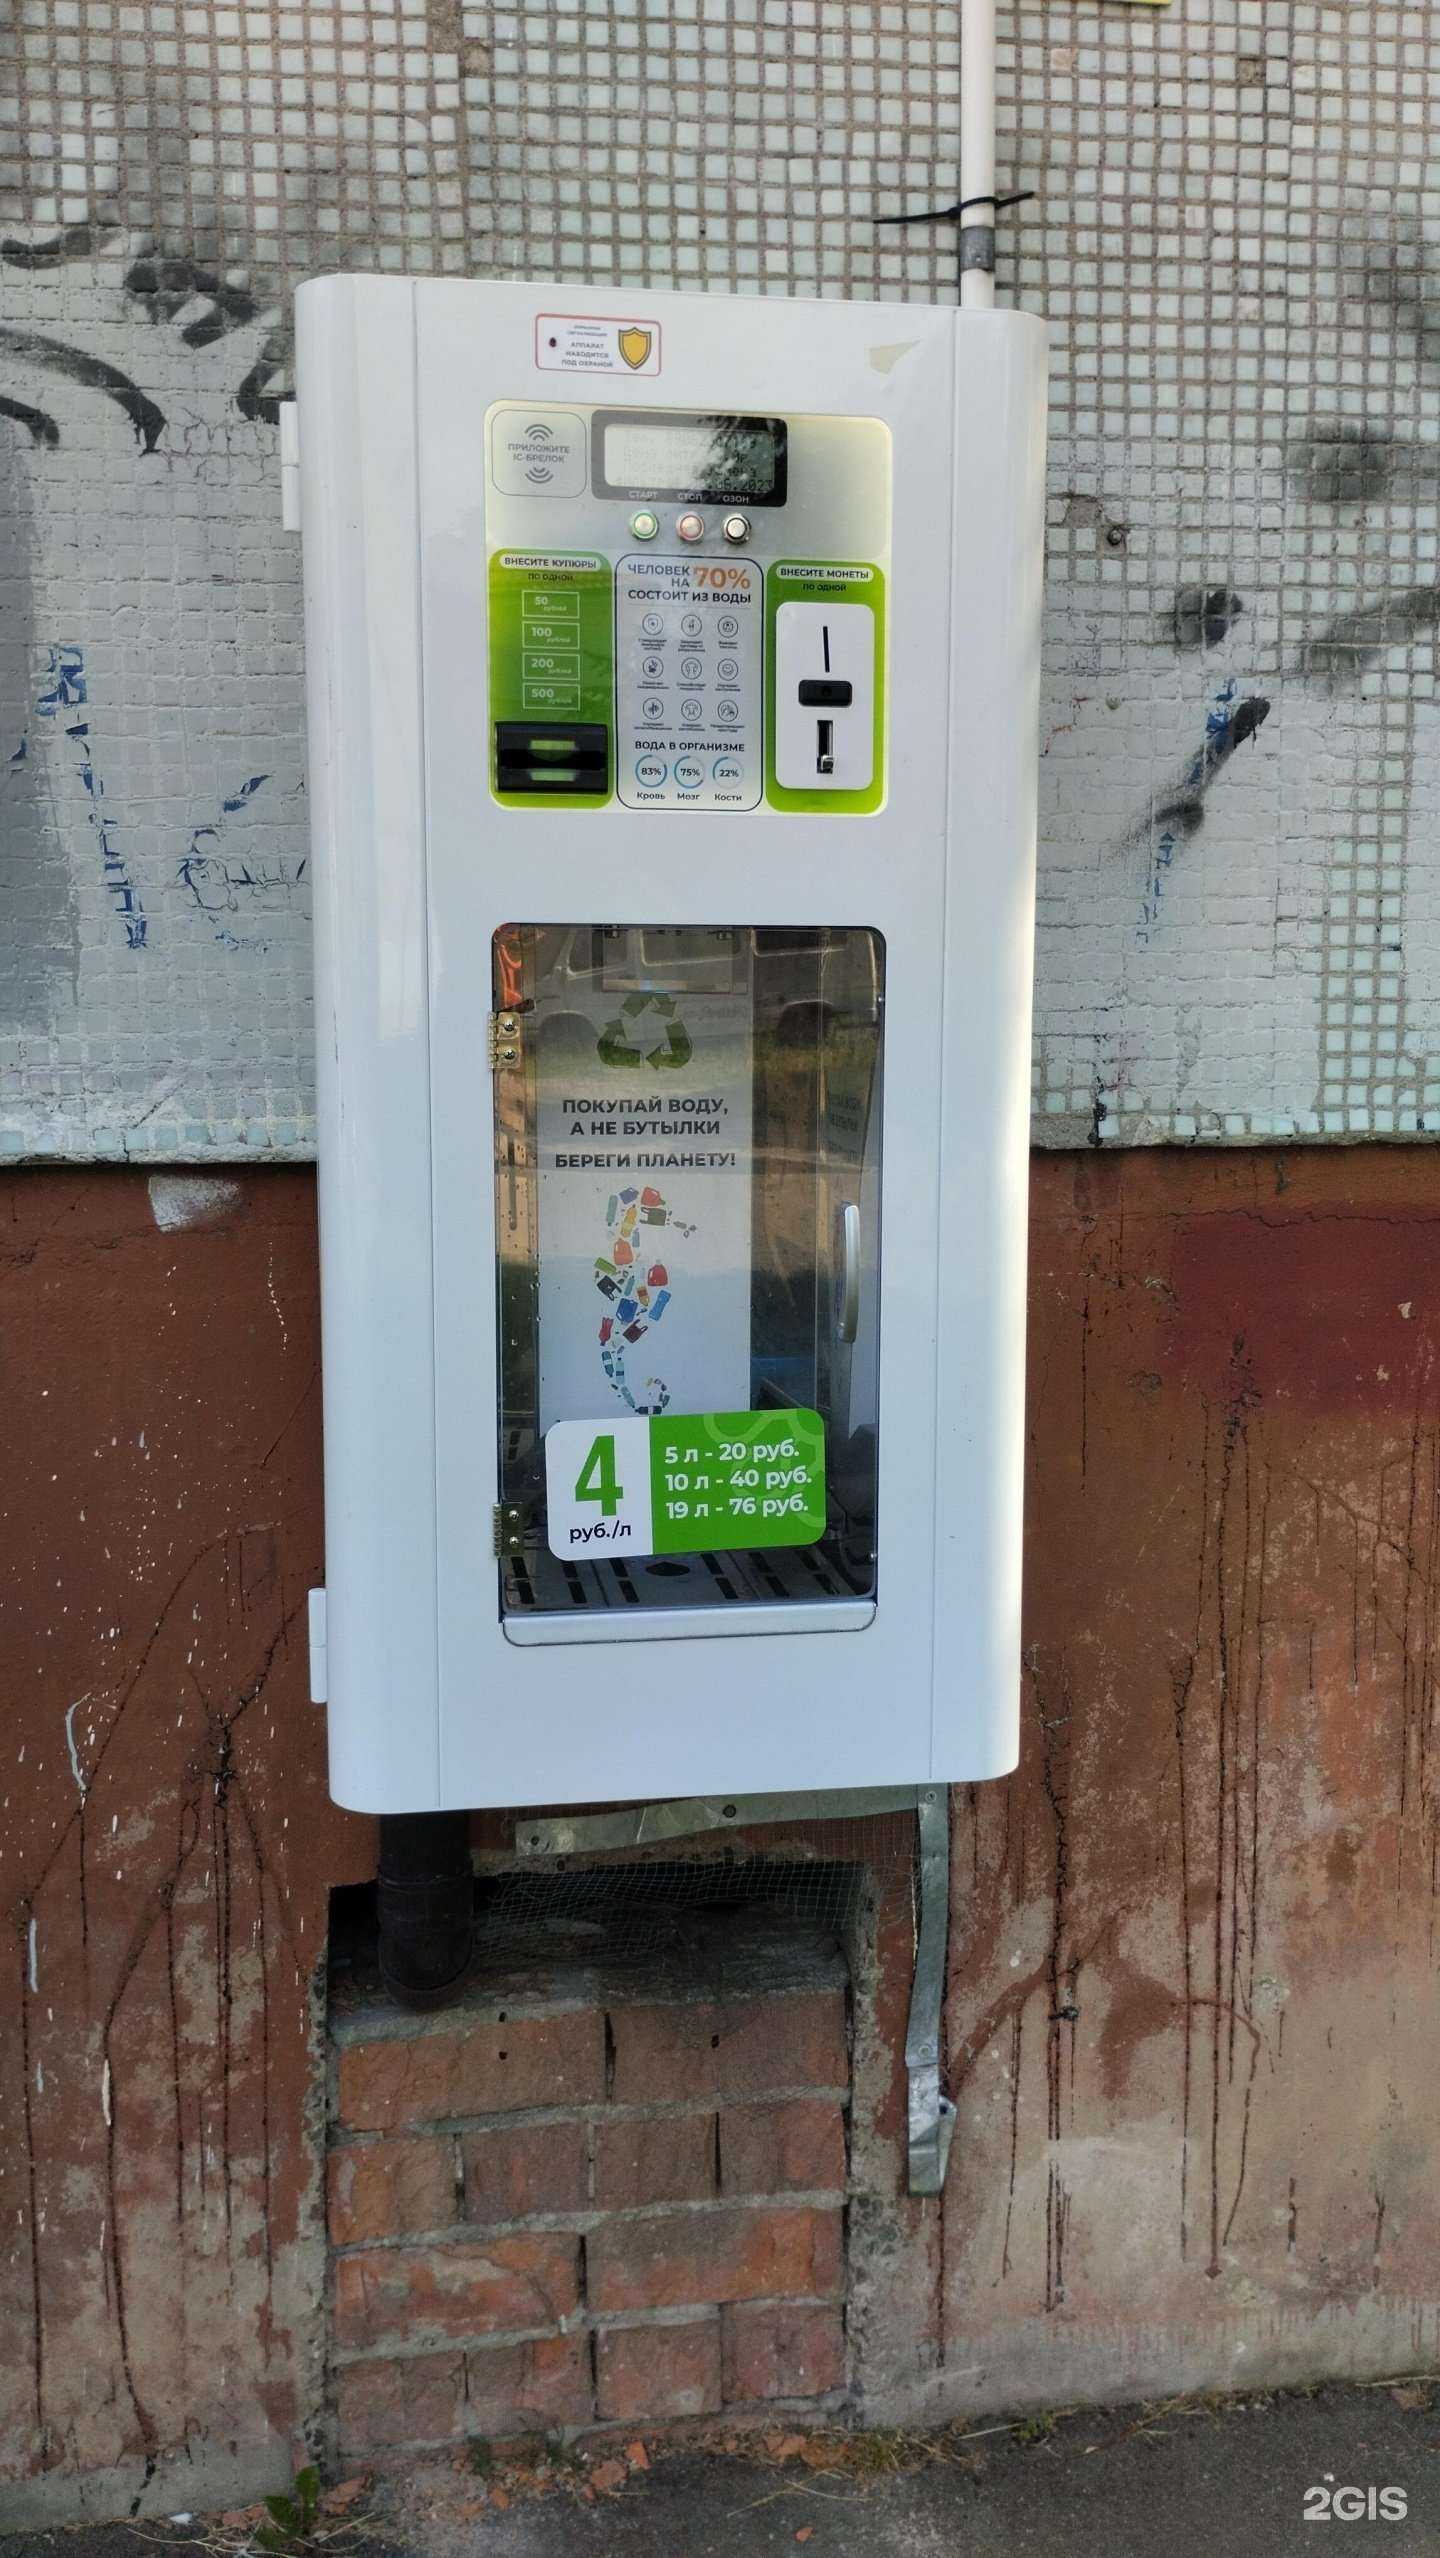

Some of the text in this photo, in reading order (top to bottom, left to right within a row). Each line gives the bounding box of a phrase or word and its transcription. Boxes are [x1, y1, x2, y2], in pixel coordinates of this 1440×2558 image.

[570, 341, 605, 350] АППАРАТ
[565, 351, 609, 359] НАХОДИТСЯ
[561, 359, 577, 367] ПОД
[507, 443, 570, 454] ПРИЛОЖИТЕ
[628, 490, 659, 500] СТАРТ
[677, 492, 704, 502] СТОП
[722, 494, 750, 504] ОЗОН
[504, 557, 597, 569] ВНЕСИТЕ КУПЮРЫ
[628, 564, 752, 590] ЧЕЛОВЕК 70%
[780, 567, 869, 579] ВНЕСИТЕ МОНЕТЫ
[671, 578, 690, 588] НА
[534, 596, 549, 606] 50
[628, 589, 752, 605] СОСТОИТ ИЗ ВОДЫ
[531, 627, 553, 637] 100
[531, 658, 554, 669] 200
[531, 688, 555, 699] 500
[634, 741, 746, 753] ВОДА В ОРГАНИЗМЕ
[641, 767, 662, 776] 83%
[680, 768, 701, 777] 75%
[719, 769, 740, 778] 22%
[636, 791, 666, 801] Кровь
[677, 792, 701, 801] Мозг
[714, 793, 743, 802] Кости
[562, 1096, 729, 1115] ПОКУПАЙ ВОДУ,
[570, 1121, 720, 1136] А НЕ БУТЫЛКИ
[555, 1152, 736, 1168] БЕРЕГИ ПЛАНЕТУ!
[664, 1446, 679, 1464] 5
[683, 1449, 699, 1463] л
[719, 1443, 747, 1461] 20
[752, 1438, 800, 1464] руб.
[574, 1434, 624, 1517] 4
[665, 1473, 689, 1491] 10
[694, 1476, 710, 1490] л
[730, 1469, 760, 1488] 40
[765, 1465, 813, 1491] руб.
[665, 1501, 689, 1519] 19
[694, 1504, 710, 1518] л
[729, 1497, 757, 1516] 76
[762, 1493, 809, 1518] руб.
[569, 1519, 632, 1544] руб./л
